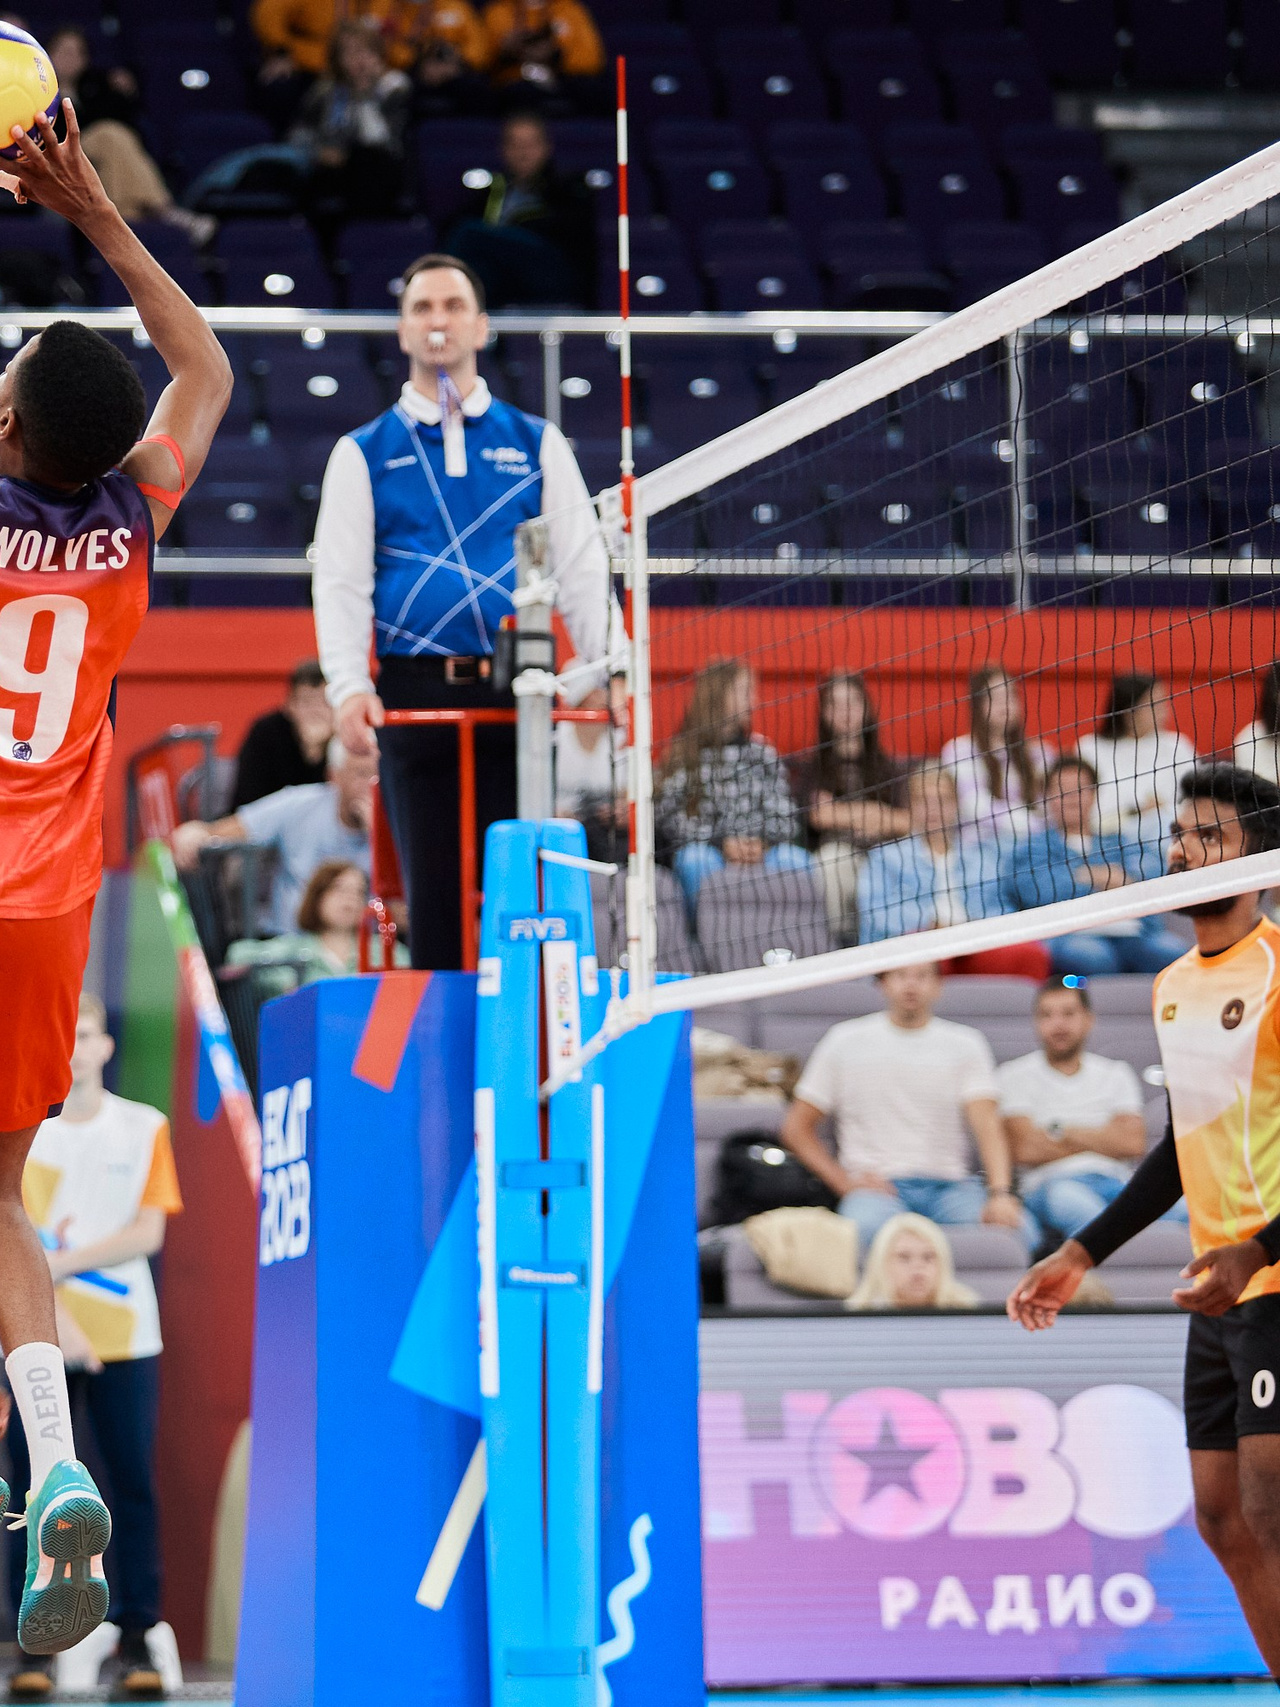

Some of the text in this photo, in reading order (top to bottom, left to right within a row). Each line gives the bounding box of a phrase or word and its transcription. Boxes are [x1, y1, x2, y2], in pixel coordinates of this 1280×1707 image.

[26, 1366, 63, 1443] AERO
[1251, 1369, 1276, 1408] 0
[879, 1572, 1155, 1634] РАДИО
